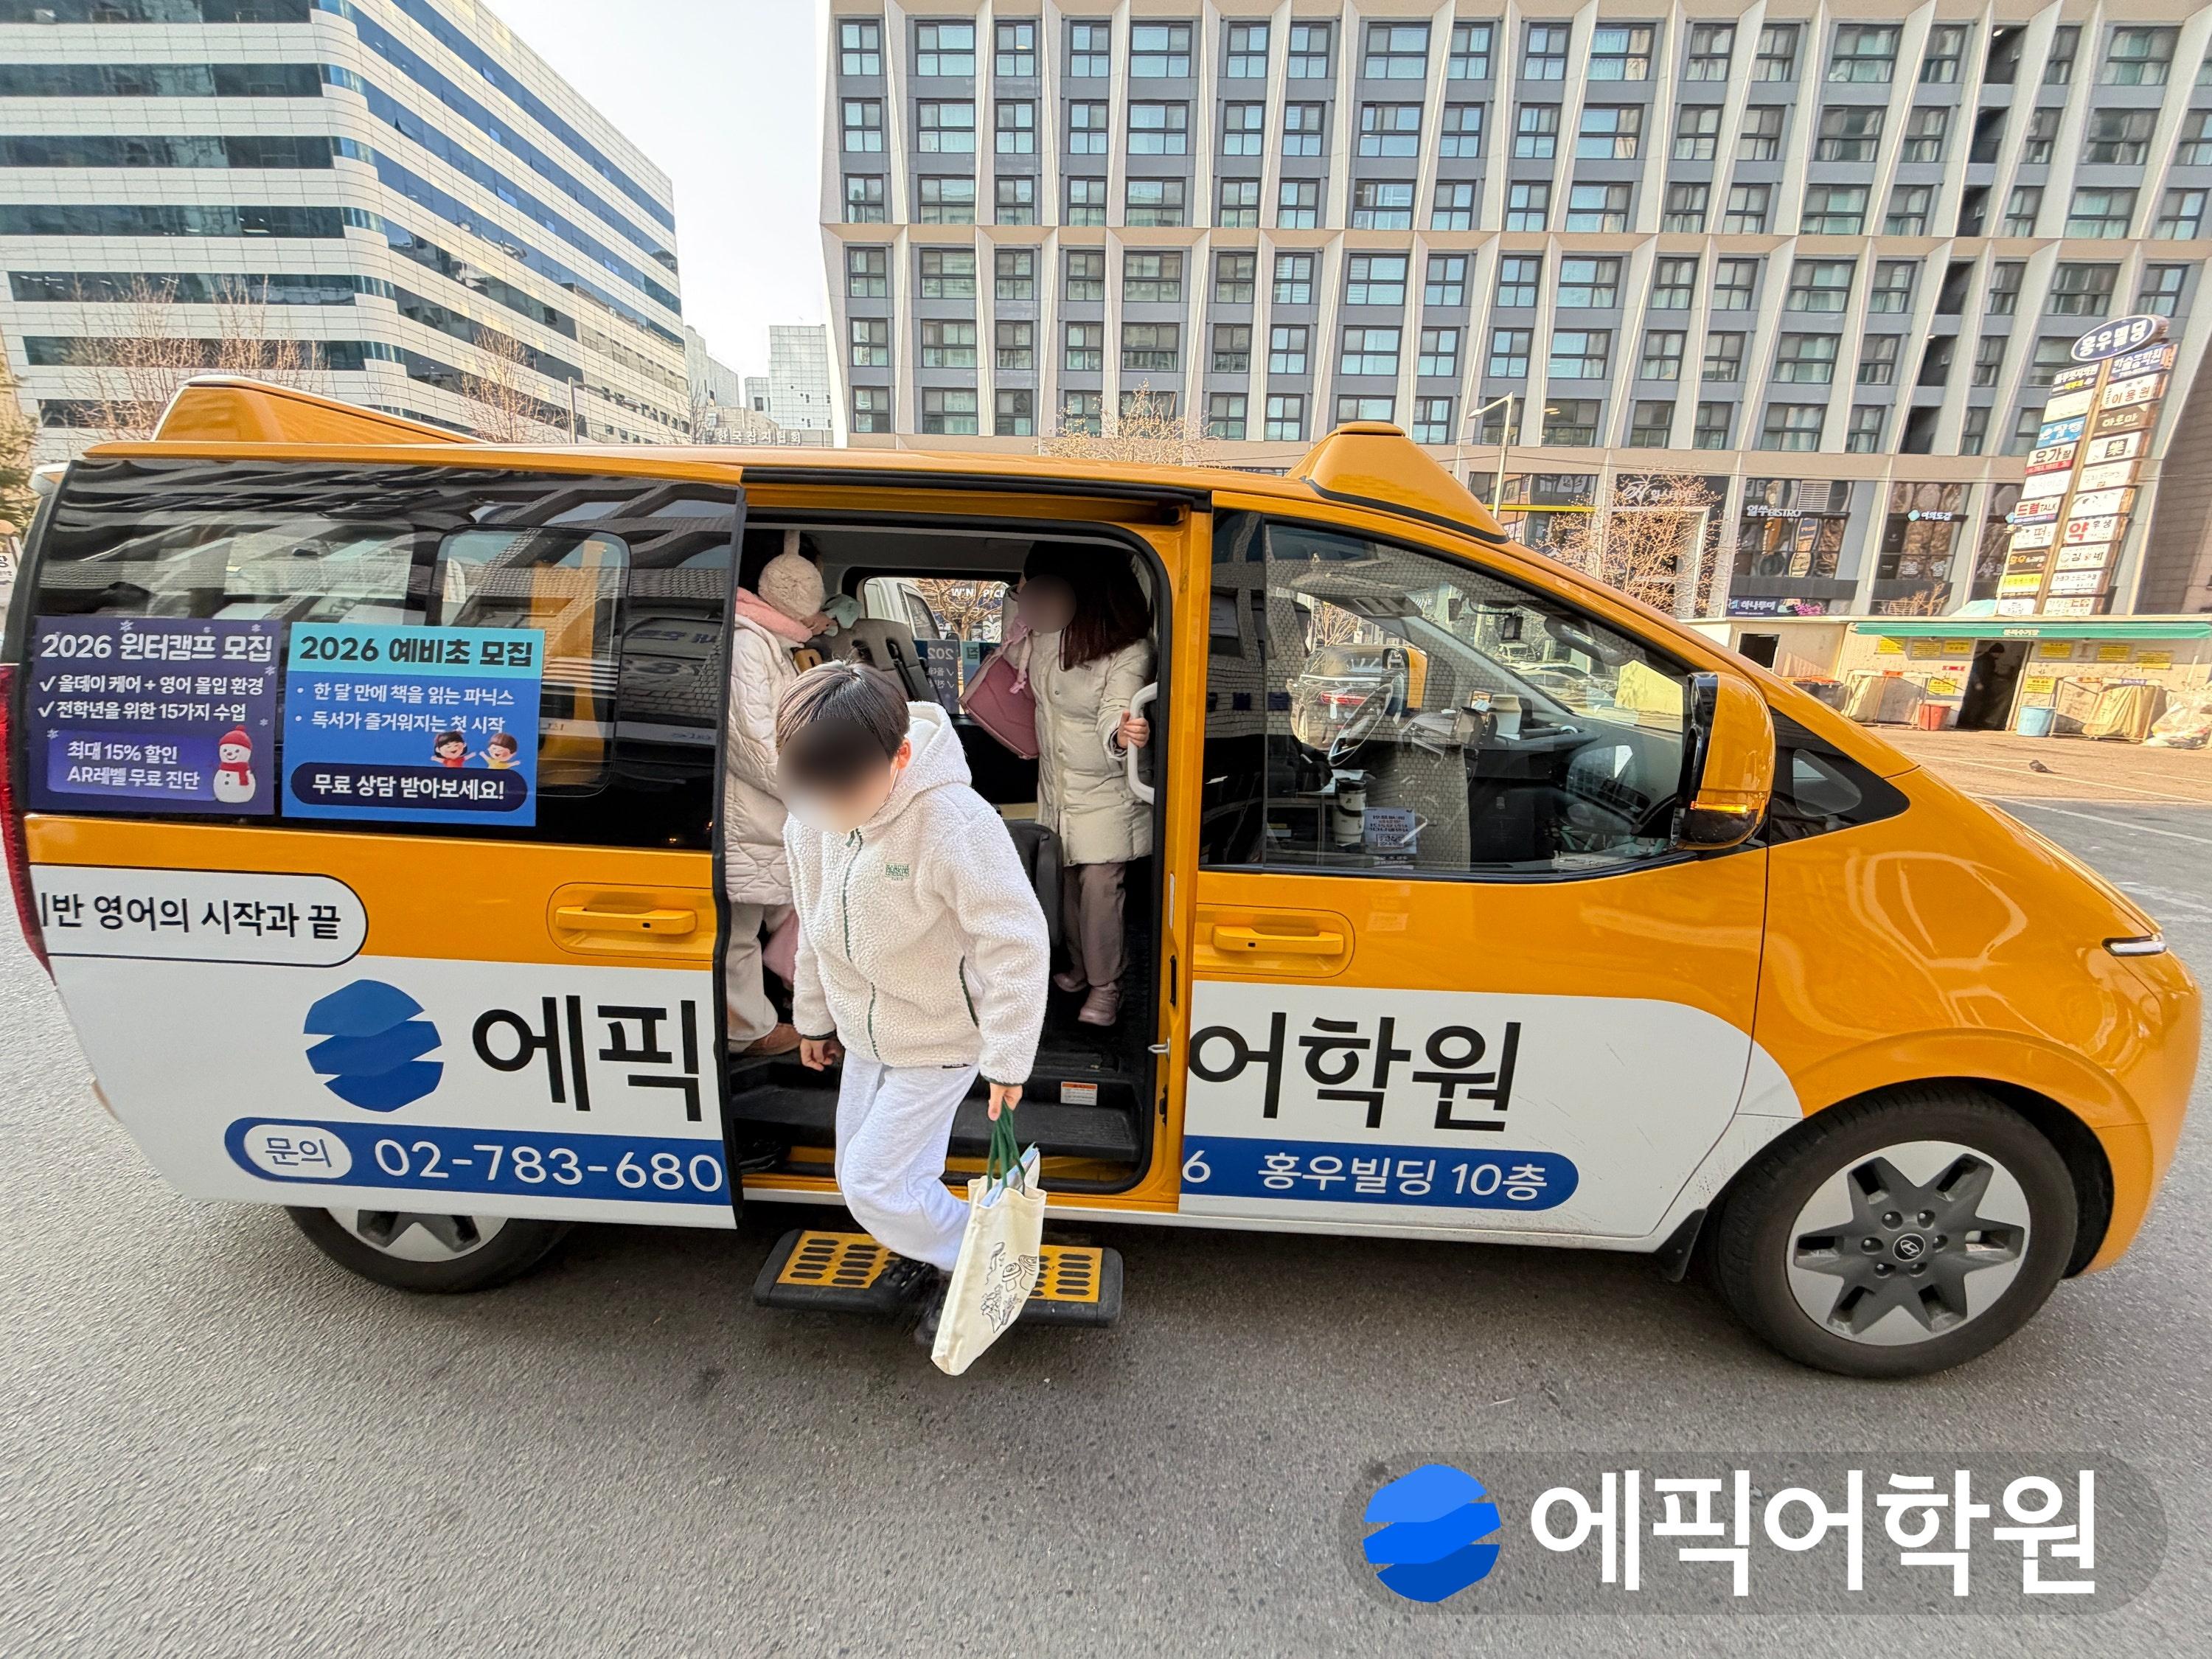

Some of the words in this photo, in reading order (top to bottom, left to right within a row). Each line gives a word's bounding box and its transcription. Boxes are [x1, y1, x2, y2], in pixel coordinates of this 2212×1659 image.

[716, 428, 801, 443] 한국잡지협회
[2068, 521, 2090, 541] 약
[1741, 600, 1775, 611] 하나투어
[41, 634, 111, 658] 2026
[119, 633, 217, 661] 윈터캠프
[222, 635, 273, 662] 모집
[299, 636, 379, 661] 2026
[389, 638, 471, 664] 예비초
[479, 641, 532, 667] 모집
[58, 675, 105, 692] 올데이
[108, 675, 142, 693] 케어
[159, 676, 191, 695] 영어
[195, 677, 226, 695] 몰입
[230, 677, 264, 695] 환경
[313, 683, 331, 700] 한
[334, 684, 352, 701] 달
[354, 684, 387, 702] 만에
[390, 685, 424, 704] 책을
[428, 687, 461, 705] 읽는
[463, 688, 515, 706] 파닉스
[56, 700, 122, 720] 전학년을
[122, 702, 156, 720] 위한
[159, 703, 209, 721] 15가지
[213, 704, 246, 722] 수업
[310, 711, 361, 729] 독서가
[364, 713, 447, 732] 즐거워지는
[450, 715, 467, 732] 첫
[471, 716, 505, 734] 시작
[67, 740, 100, 760] 최대
[104, 743, 142, 761] 15%
[144, 745, 177, 765] 할인
[67, 767, 127, 786] AR레벨
[128, 768, 164, 787] 무료
[165, 771, 200, 790] 진단
[312, 773, 352, 795] 무료
[356, 775, 396, 797] 상담
[400, 776, 504, 801] 받아보세요!
[94, 894, 189, 933] 영어의
[201, 900, 299, 937] 시작과
[307, 905, 341, 940] 끝
[472, 995, 703, 1122] 에픽
[1188, 1011, 1521, 1133] 어학원
[265, 1137, 333, 1169] 문의
[374, 1138, 723, 1194] 02-783-680
[1258, 1152, 1436, 1196] 홍우빌딩
[1450, 1162, 1548, 1201] 10층
